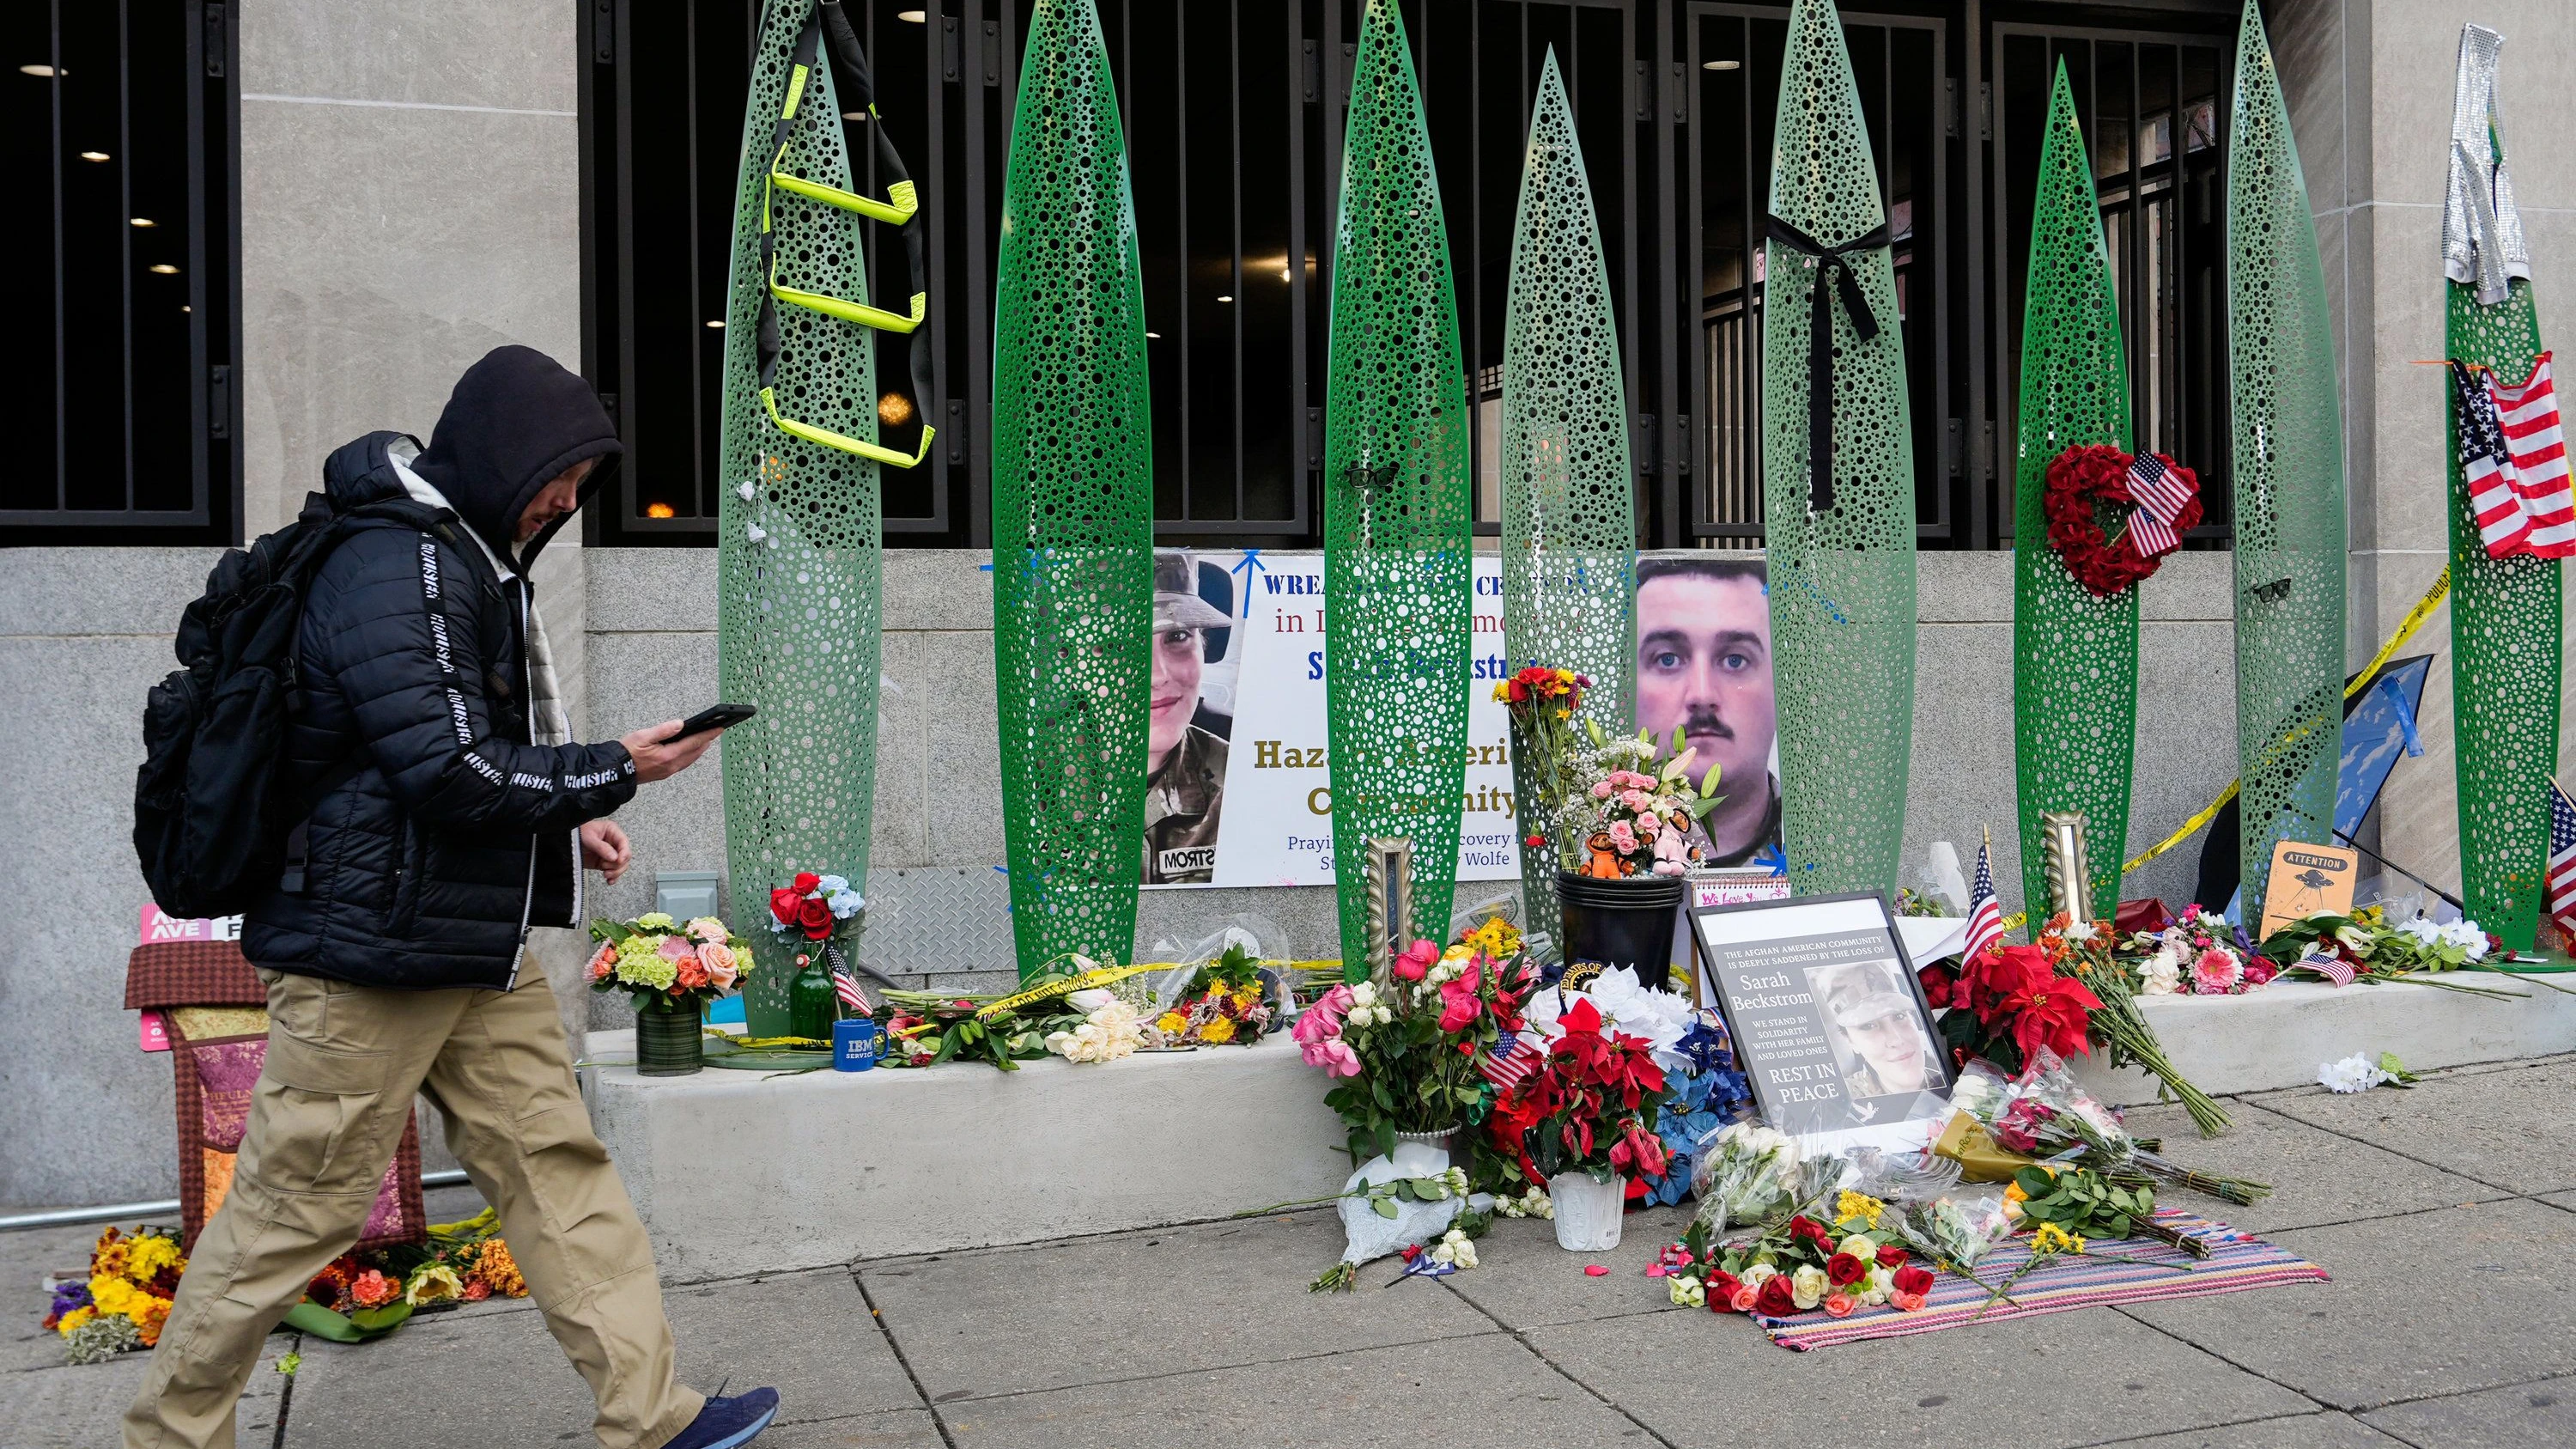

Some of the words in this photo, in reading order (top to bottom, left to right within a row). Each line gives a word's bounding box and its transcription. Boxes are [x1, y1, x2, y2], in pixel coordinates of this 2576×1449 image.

[1275, 608, 1304, 633] in
[1466, 851, 1510, 867] Wolfe
[2287, 854, 2341, 869] ATTENTION
[1702, 892, 1718, 904] We
[1722, 892, 1744, 904] Love
[151, 922, 200, 940] AVE
[1724, 950, 1743, 959] THE
[1745, 947, 1779, 958] AFGHAN
[1782, 941, 1827, 953] AMERICAN
[1828, 935, 1882, 948] COMMUNITY
[1739, 958, 1770, 968] DEEPLY
[1771, 953, 1818, 965] SADDENED
[1820, 951, 1830, 959] BY
[1832, 949, 1850, 959] THE
[1851, 947, 1873, 956] LOSS
[1874, 946, 1886, 954] OF
[1588, 962, 1601, 972] OF
[1740, 971, 1791, 990] Sarah
[1731, 992, 1814, 1011] Beckstrom
[1752, 1020, 1768, 1028] WE
[1769, 1017, 1796, 1026] STAND
[1797, 1015, 1808, 1024] IN
[1758, 1026, 1808, 1039] SOLIDARITY
[848, 1038, 872, 1053] IBM
[1753, 1040, 1777, 1050] WITH
[1777, 1038, 1795, 1048] HER
[1796, 1035, 1825, 1046] FAMILY
[1758, 1052, 1775, 1061] AND
[1776, 1049, 1804, 1059] LOVED
[1805, 1045, 1828, 1056] ONES
[1768, 1065, 1813, 1084] REST
[1814, 1062, 1837, 1079] IN
[1778, 1083, 1839, 1104] PEACE
